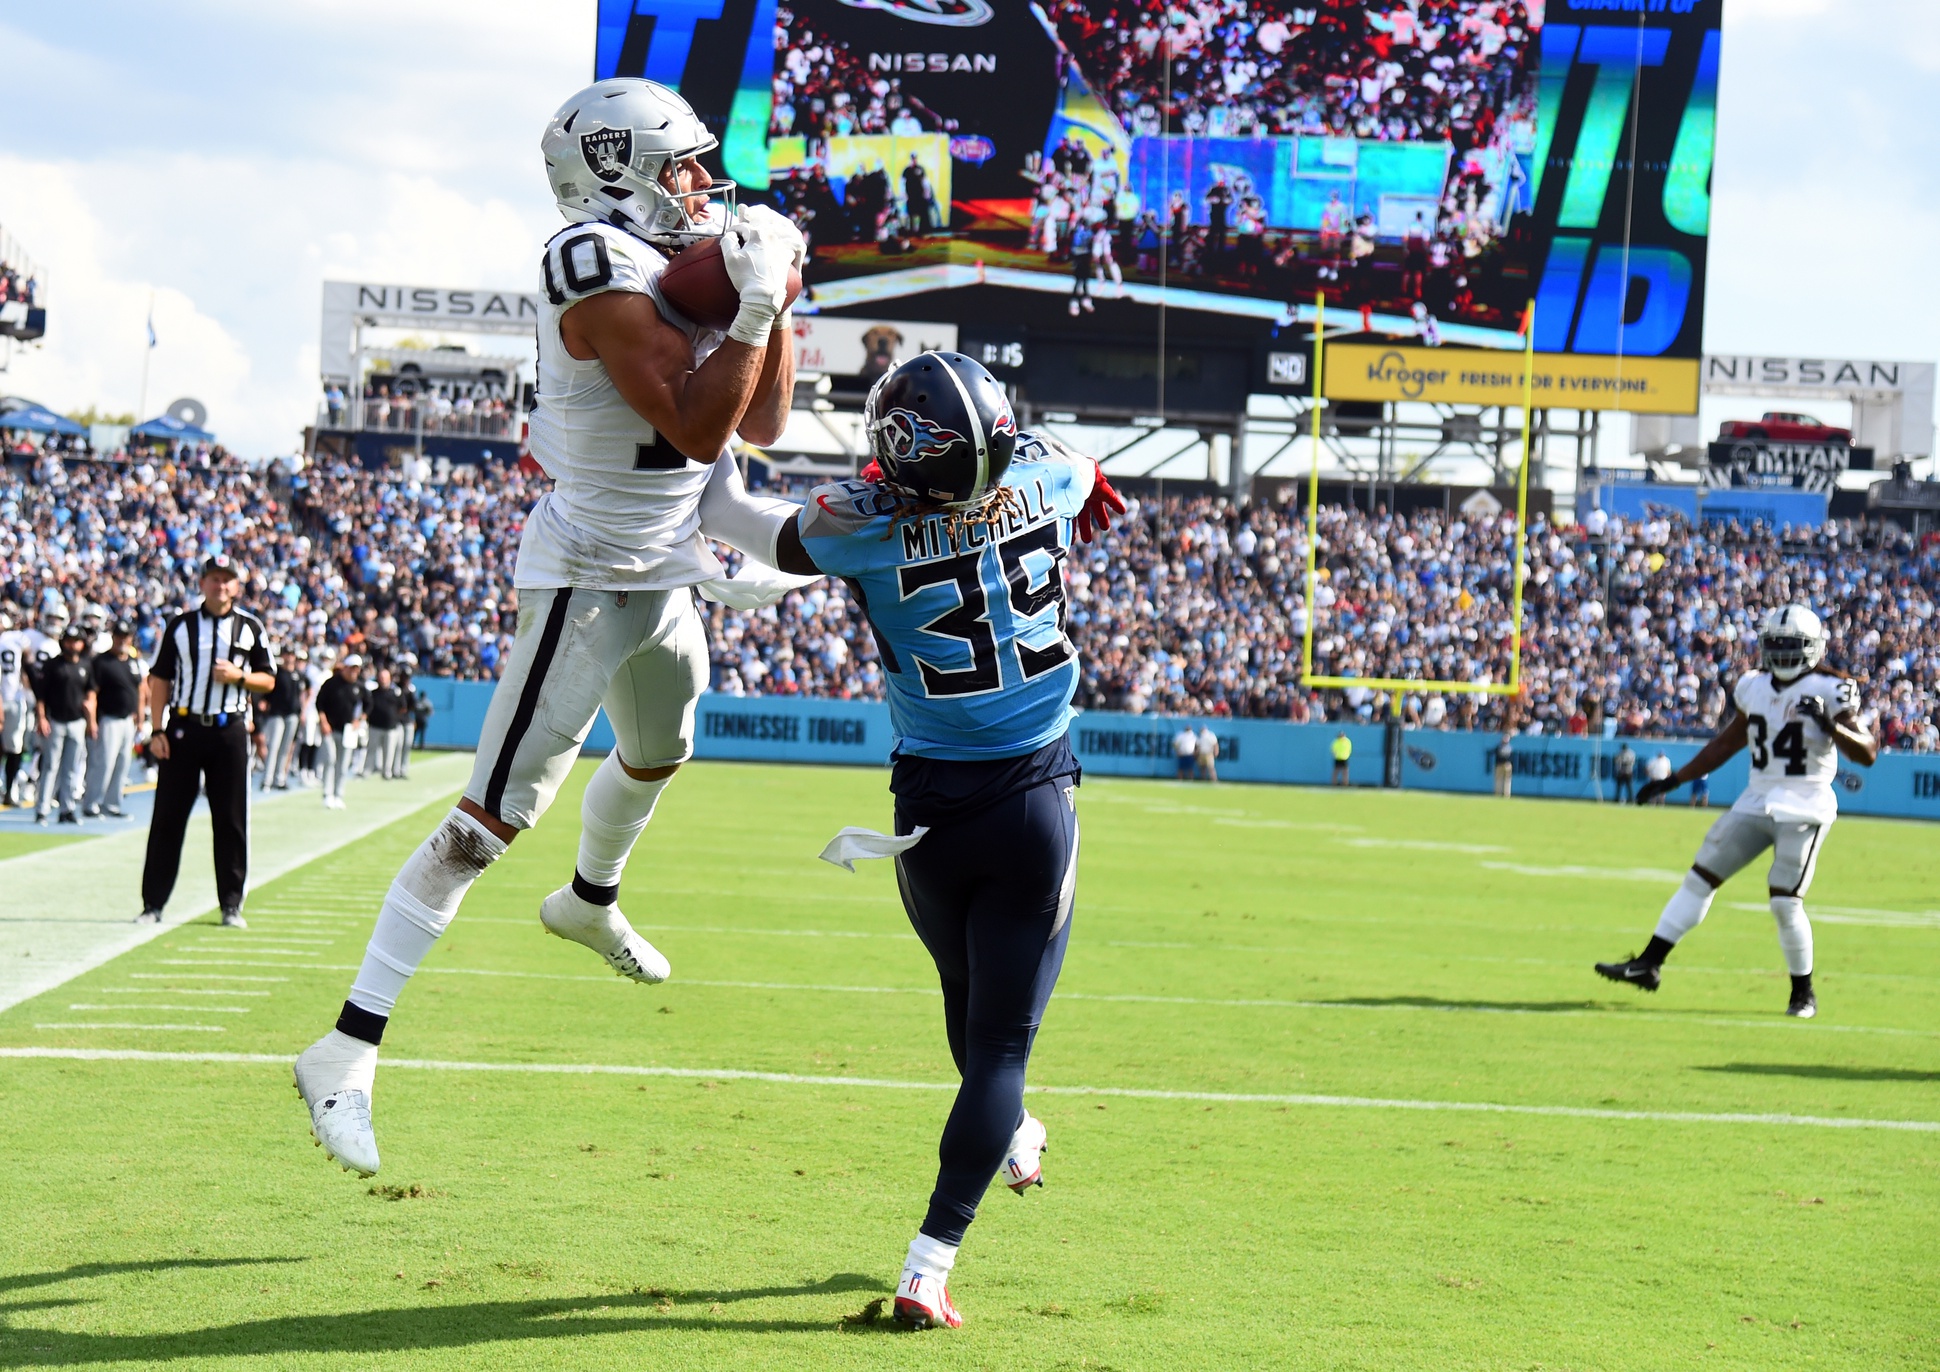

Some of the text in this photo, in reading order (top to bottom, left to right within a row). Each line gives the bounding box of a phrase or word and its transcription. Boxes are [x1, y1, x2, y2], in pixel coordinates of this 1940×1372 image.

[868, 52, 996, 73] NISSAN
[585, 131, 627, 143] RAIDERS
[542, 233, 612, 305] 10
[1367, 350, 1447, 399] Kroger
[1460, 371, 1512, 387] FRESH
[1709, 356, 1899, 386] NISSAN
[900, 477, 1058, 562] MITCHELL
[897, 519, 1079, 698] 39
[704, 712, 865, 745] TENNESSEE TOUGH
[1747, 713, 1808, 776] 34
